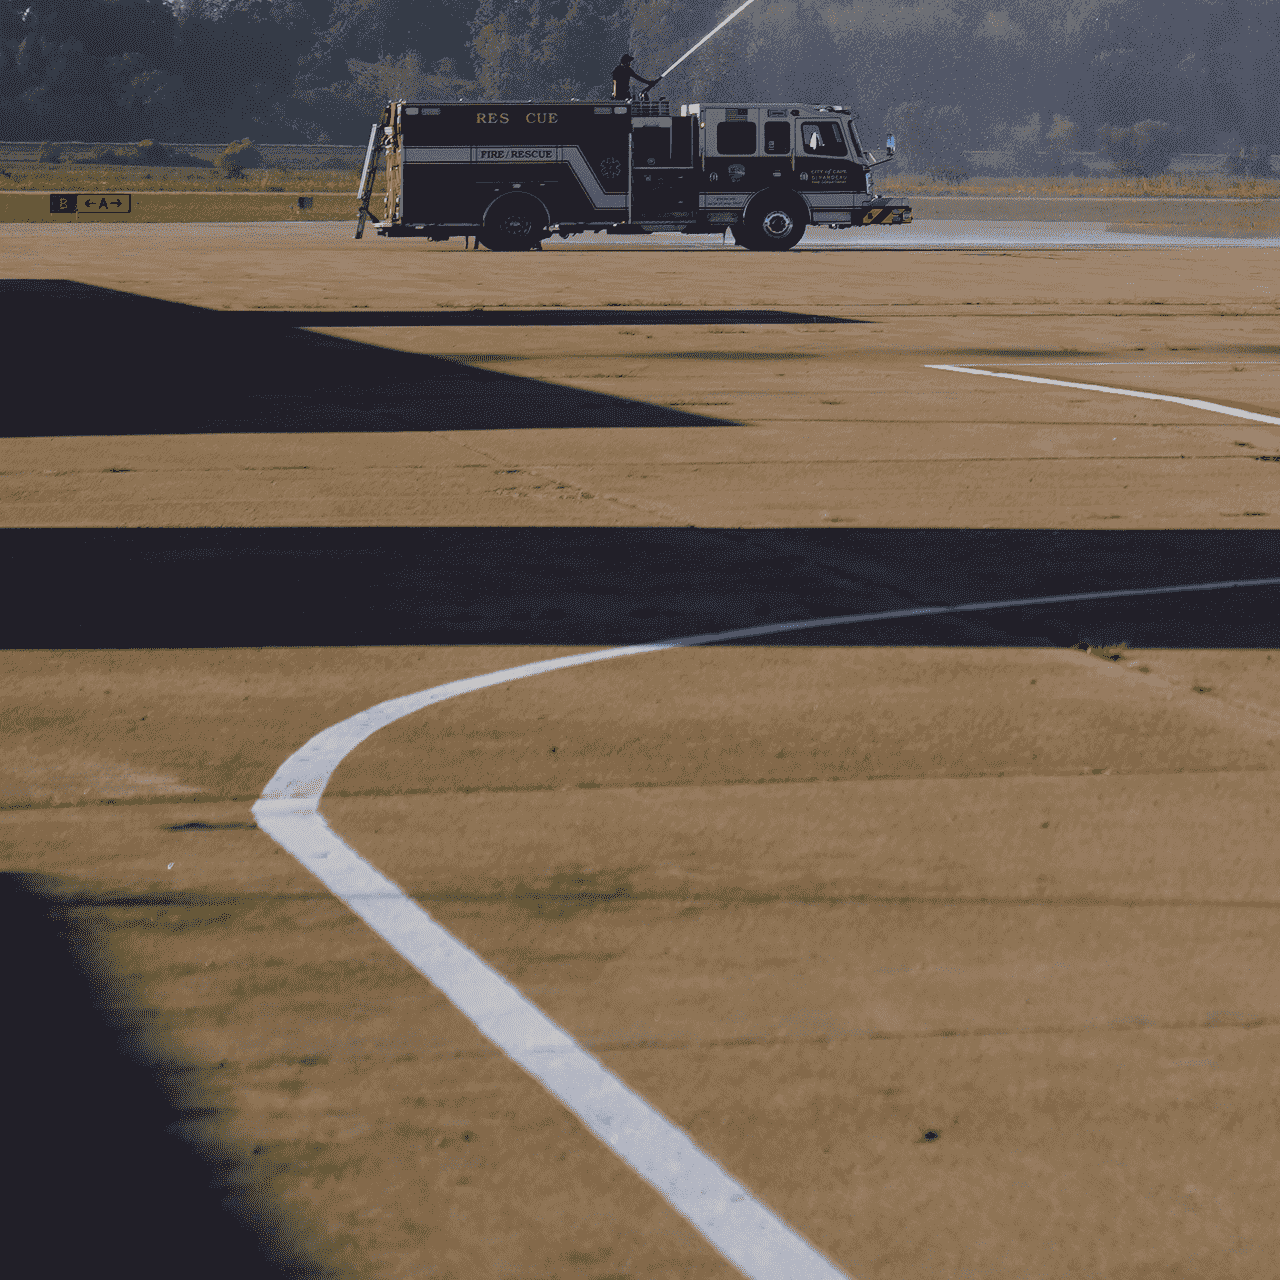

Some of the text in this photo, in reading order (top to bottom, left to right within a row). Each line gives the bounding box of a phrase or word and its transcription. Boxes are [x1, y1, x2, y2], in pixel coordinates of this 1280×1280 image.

[476, 113, 558, 124] RES CUE
[60, 198, 108, 209] B A
